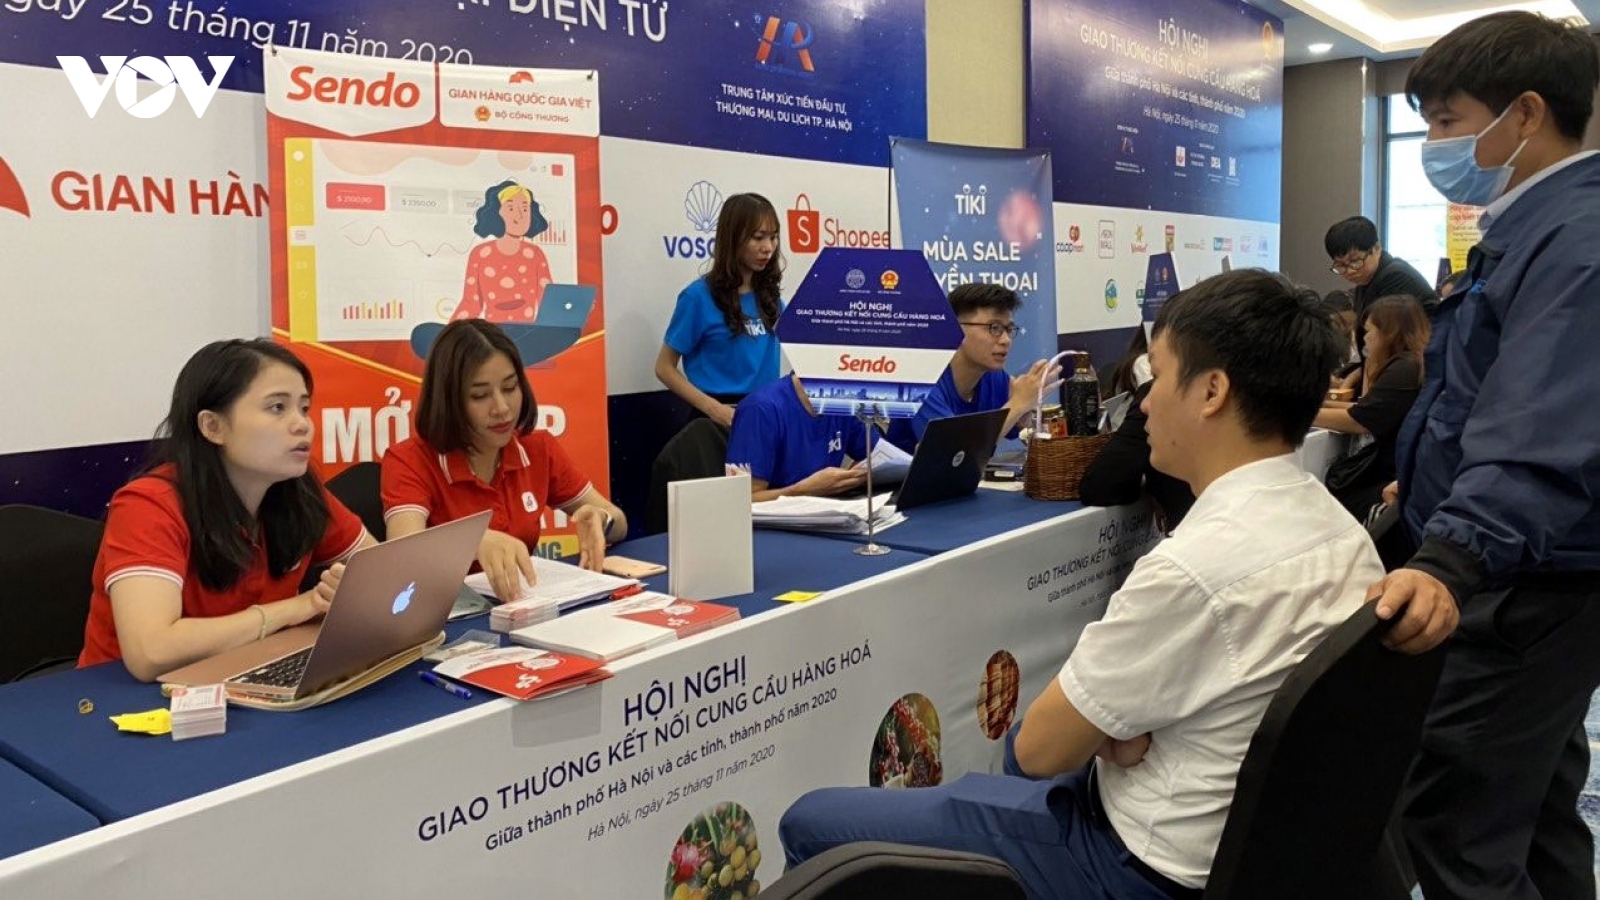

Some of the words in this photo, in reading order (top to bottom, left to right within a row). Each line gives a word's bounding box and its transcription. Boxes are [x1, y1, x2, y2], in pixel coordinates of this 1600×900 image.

[101, 0, 153, 25] 25
[168, 1, 275, 49] tháng
[287, 19, 311, 50] 11
[321, 28, 388, 58] năm
[400, 38, 474, 66] 2020
[1080, 23, 1108, 49] GIAO
[286, 65, 420, 109] Sendo
[448, 88, 477, 99] GIAN
[479, 89, 512, 102] HÀNG
[513, 92, 545, 106] QUỐC
[547, 96, 567, 106] GIA
[568, 97, 592, 110] VIỆT
[721, 83, 754, 99] TRUNG
[755, 87, 775, 102] TÂM
[776, 92, 794, 106] XÚC
[795, 95, 814, 109] TIẾN
[495, 110, 507, 120] BỘ
[508, 111, 534, 121] CÔNG
[715, 101, 756, 117] THƯƠNG
[757, 107, 776, 122] MẠI,
[777, 111, 791, 123] DU
[791, 113, 811, 126] LỊCH
[811, 116, 824, 128] TP.
[825, 117, 837, 129] HÀ
[838, 119, 853, 132] NỘI
[51, 170, 175, 215] GIAN
[955, 183, 987, 215] TIKI
[824, 217, 889, 248] Shopee
[923, 235, 968, 262] MÙA
[973, 241, 1022, 262] SALE
[979, 271, 1039, 297] THOẠI
[849, 301, 867, 311] HỘI
[868, 302, 893, 312] NGHỊ
[838, 354, 896, 374] Sendo
[321, 386, 412, 464] MỞ
[1098, 520, 1118, 544] HỘI
[1027, 570, 1051, 591] GIAO
[624, 680, 673, 727] HỘI
[684, 654, 746, 704] NGHỊ
[418, 796, 489, 841] GIAO
[497, 751, 601, 809] THƯƠNG
[607, 727, 648, 766] KẾT
[655, 709, 690, 747] NỐI
[696, 692, 747, 728] CUNG
[752, 673, 787, 705] CẦU
[792, 657, 836, 689] HÀNG
[840, 638, 872, 670] HOÁ
[485, 826, 523, 850] Giữa
[527, 802, 572, 833] thành
[576, 784, 604, 816] phố
[608, 778, 628, 800] Hà
[631, 765, 655, 791] Nội
[657, 758, 673, 777] và
[676, 749, 698, 768] các
[701, 736, 727, 759] tỉnh,
[729, 720, 762, 745] thành
[764, 708, 785, 733] phố
[787, 702, 810, 720] năm
[811, 687, 838, 709] 2020
[587, 823, 605, 841] Hà
[608, 810, 631, 832] Nội,
[634, 797, 664, 821] ngày
[665, 787, 680, 805] 25
[682, 773, 713, 797] tháng
[715, 768, 725, 781] 11
[725, 758, 748, 778] năm
[749, 744, 776, 767] 2020
